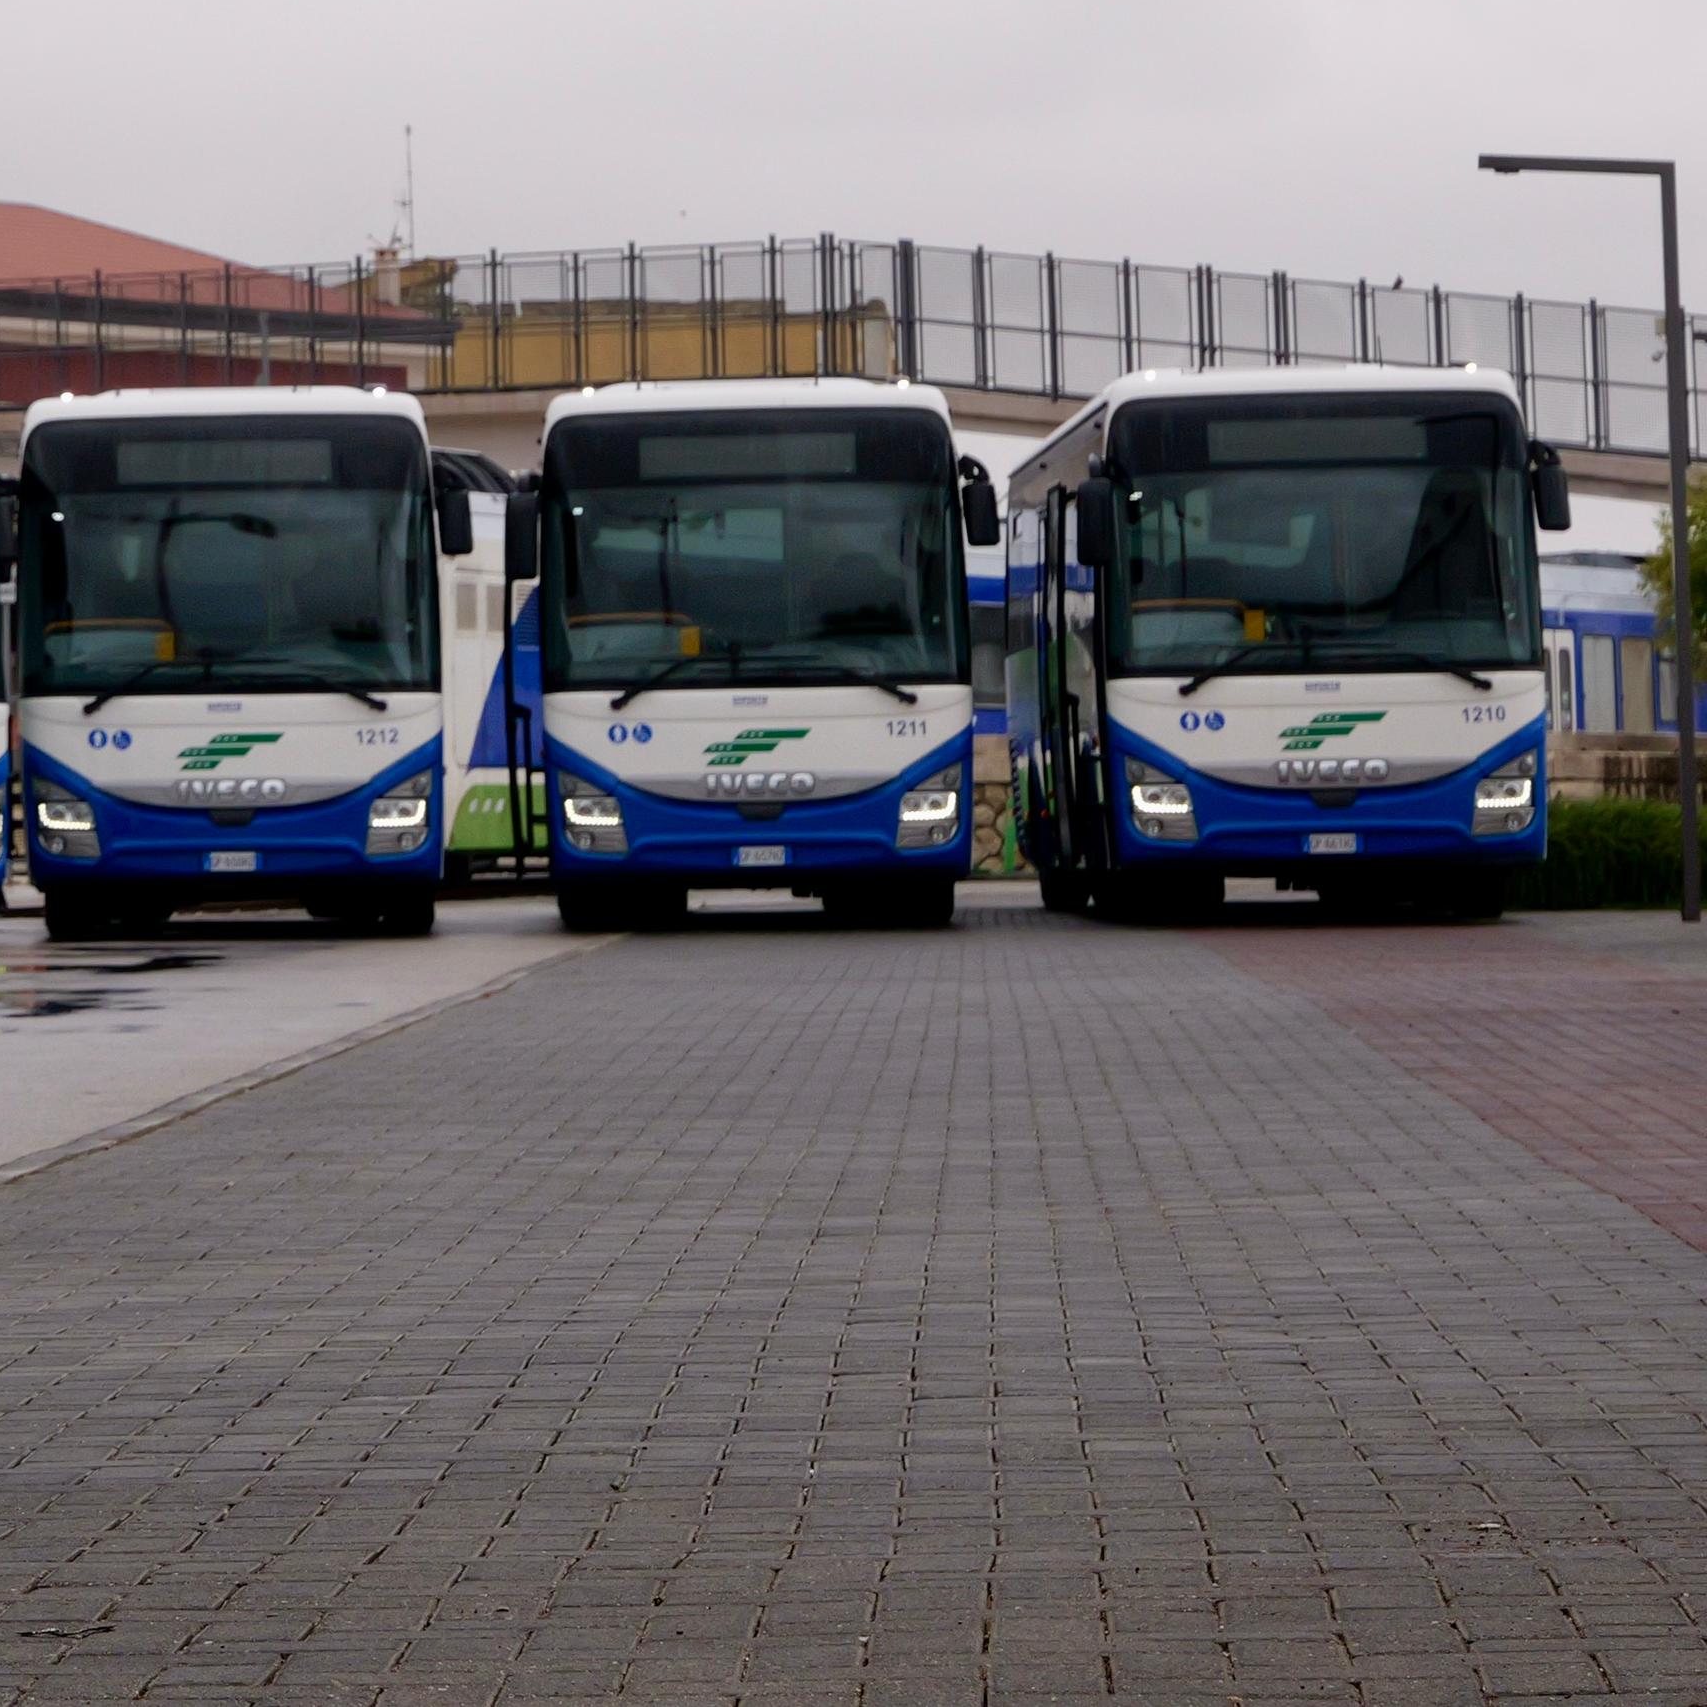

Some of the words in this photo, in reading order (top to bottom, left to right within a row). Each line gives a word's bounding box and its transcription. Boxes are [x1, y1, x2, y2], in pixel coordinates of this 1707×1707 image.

[1461, 705, 1506, 725] 1210
[356, 727, 399, 745] 1212
[886, 720, 927, 737] 1211
[1276, 759, 1389, 782] IVECO
[176, 779, 287, 801] IVECO
[706, 773, 816, 796] IVECO
